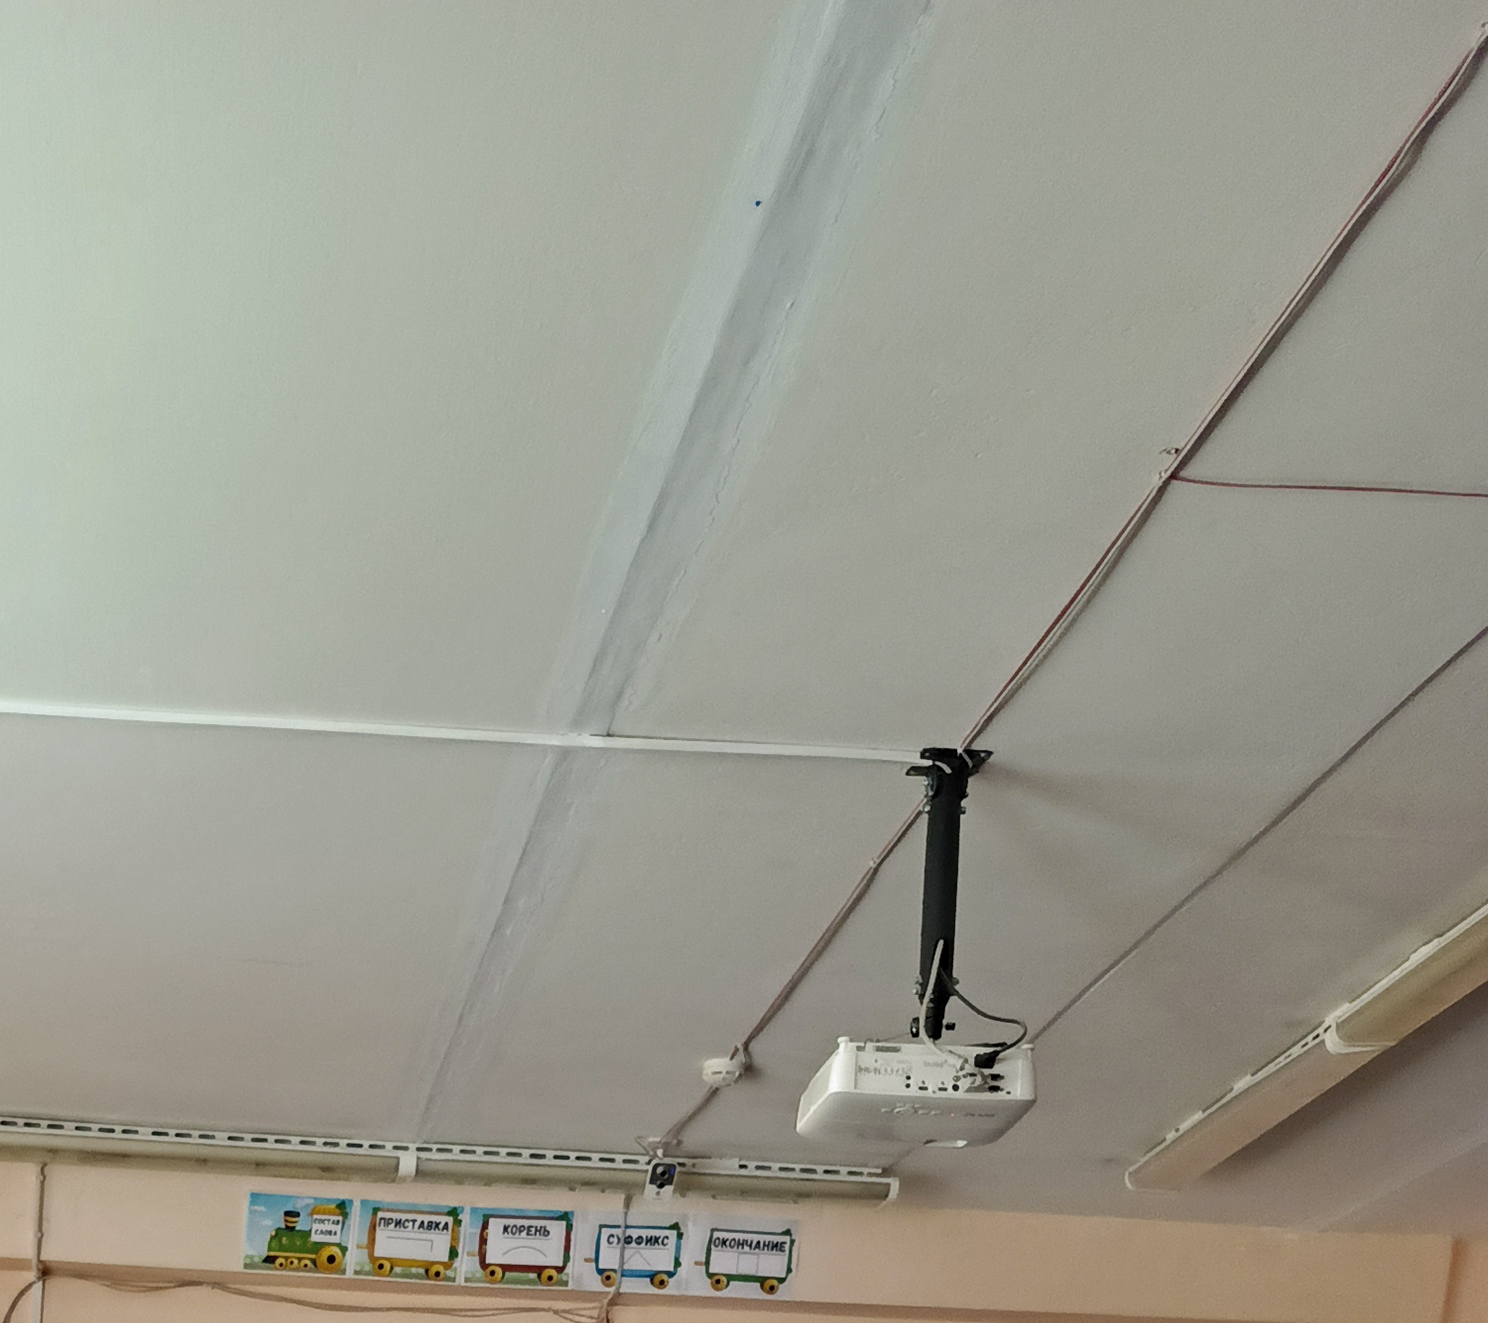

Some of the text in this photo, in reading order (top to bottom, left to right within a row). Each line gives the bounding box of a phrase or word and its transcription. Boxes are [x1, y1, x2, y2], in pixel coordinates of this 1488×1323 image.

[313, 1218, 341, 1226] СОСТАВ
[377, 1216, 450, 1233] ПРИСТАВКА
[502, 1224, 551, 1238] КОРЕНЬ
[713, 1236, 788, 1253] ОКОНЧАНИЕ
